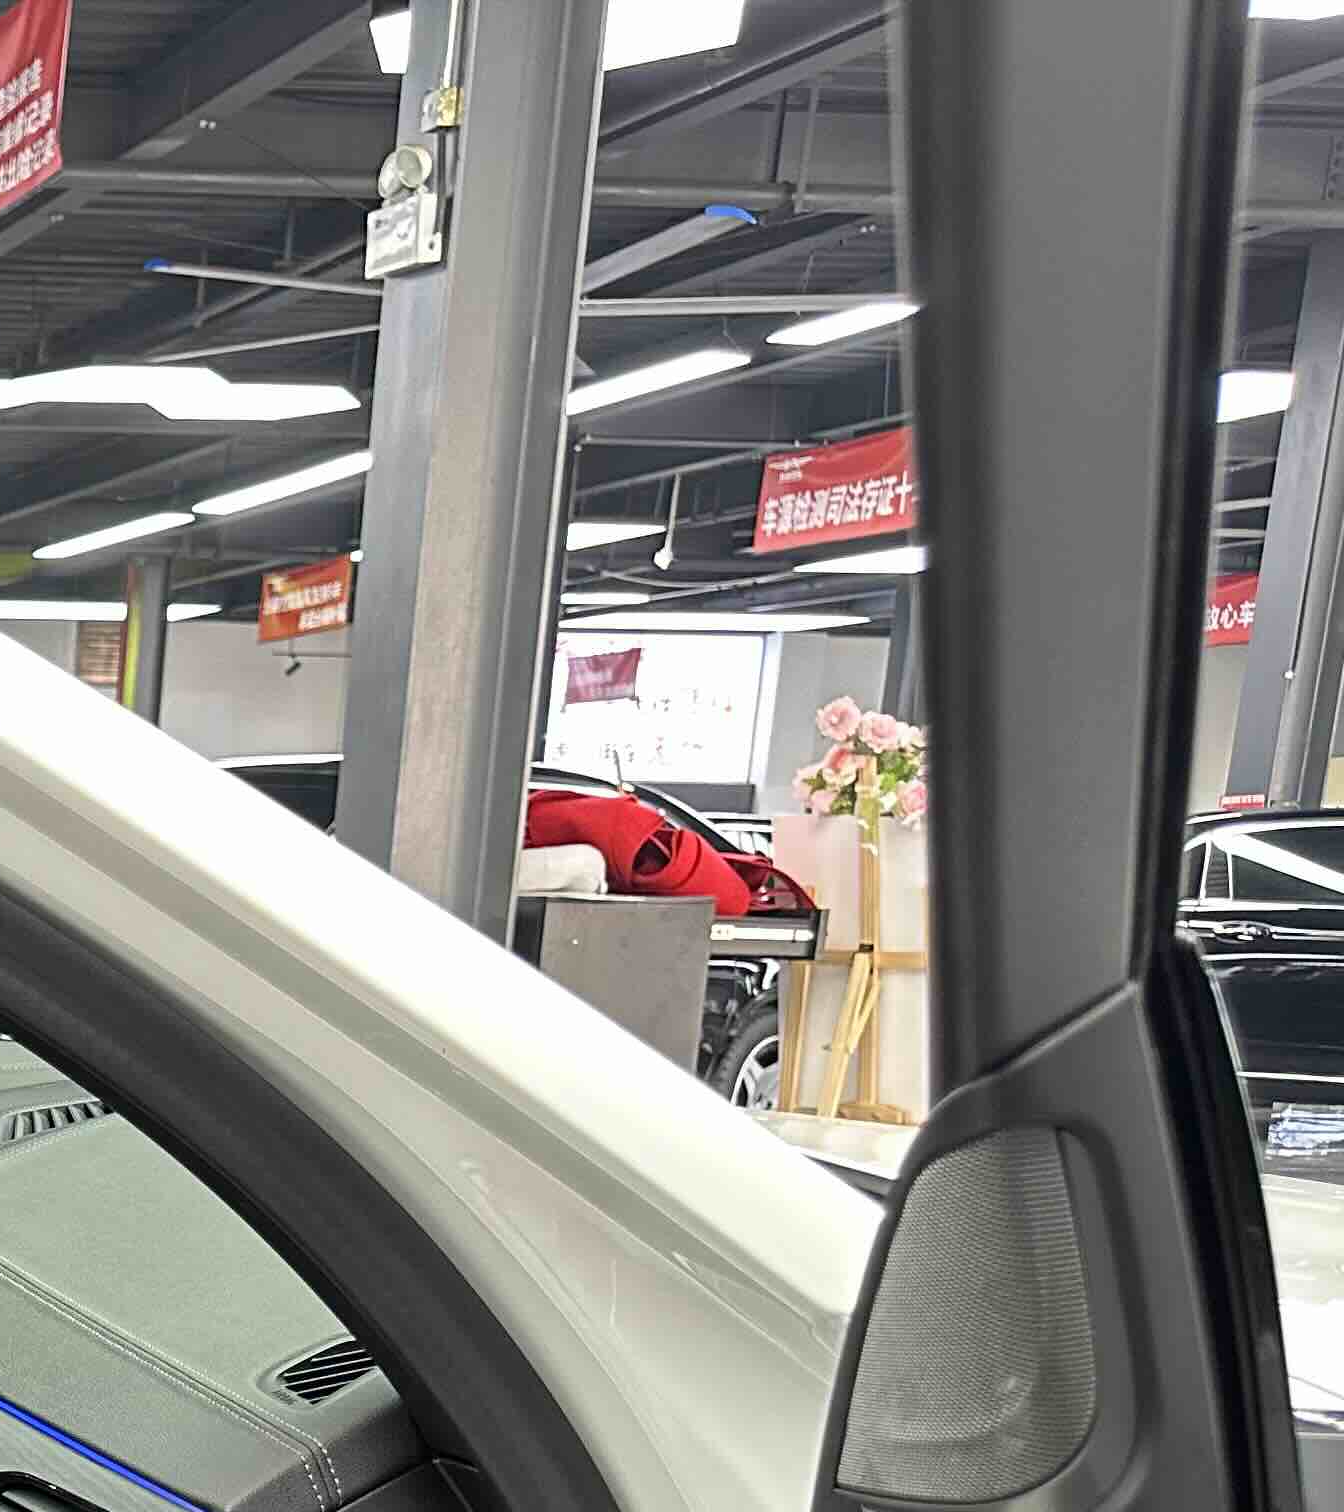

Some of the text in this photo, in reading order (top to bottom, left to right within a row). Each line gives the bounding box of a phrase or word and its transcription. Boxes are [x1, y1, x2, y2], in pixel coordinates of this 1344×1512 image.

[761, 469, 918, 537] 车源检测司法存证十
